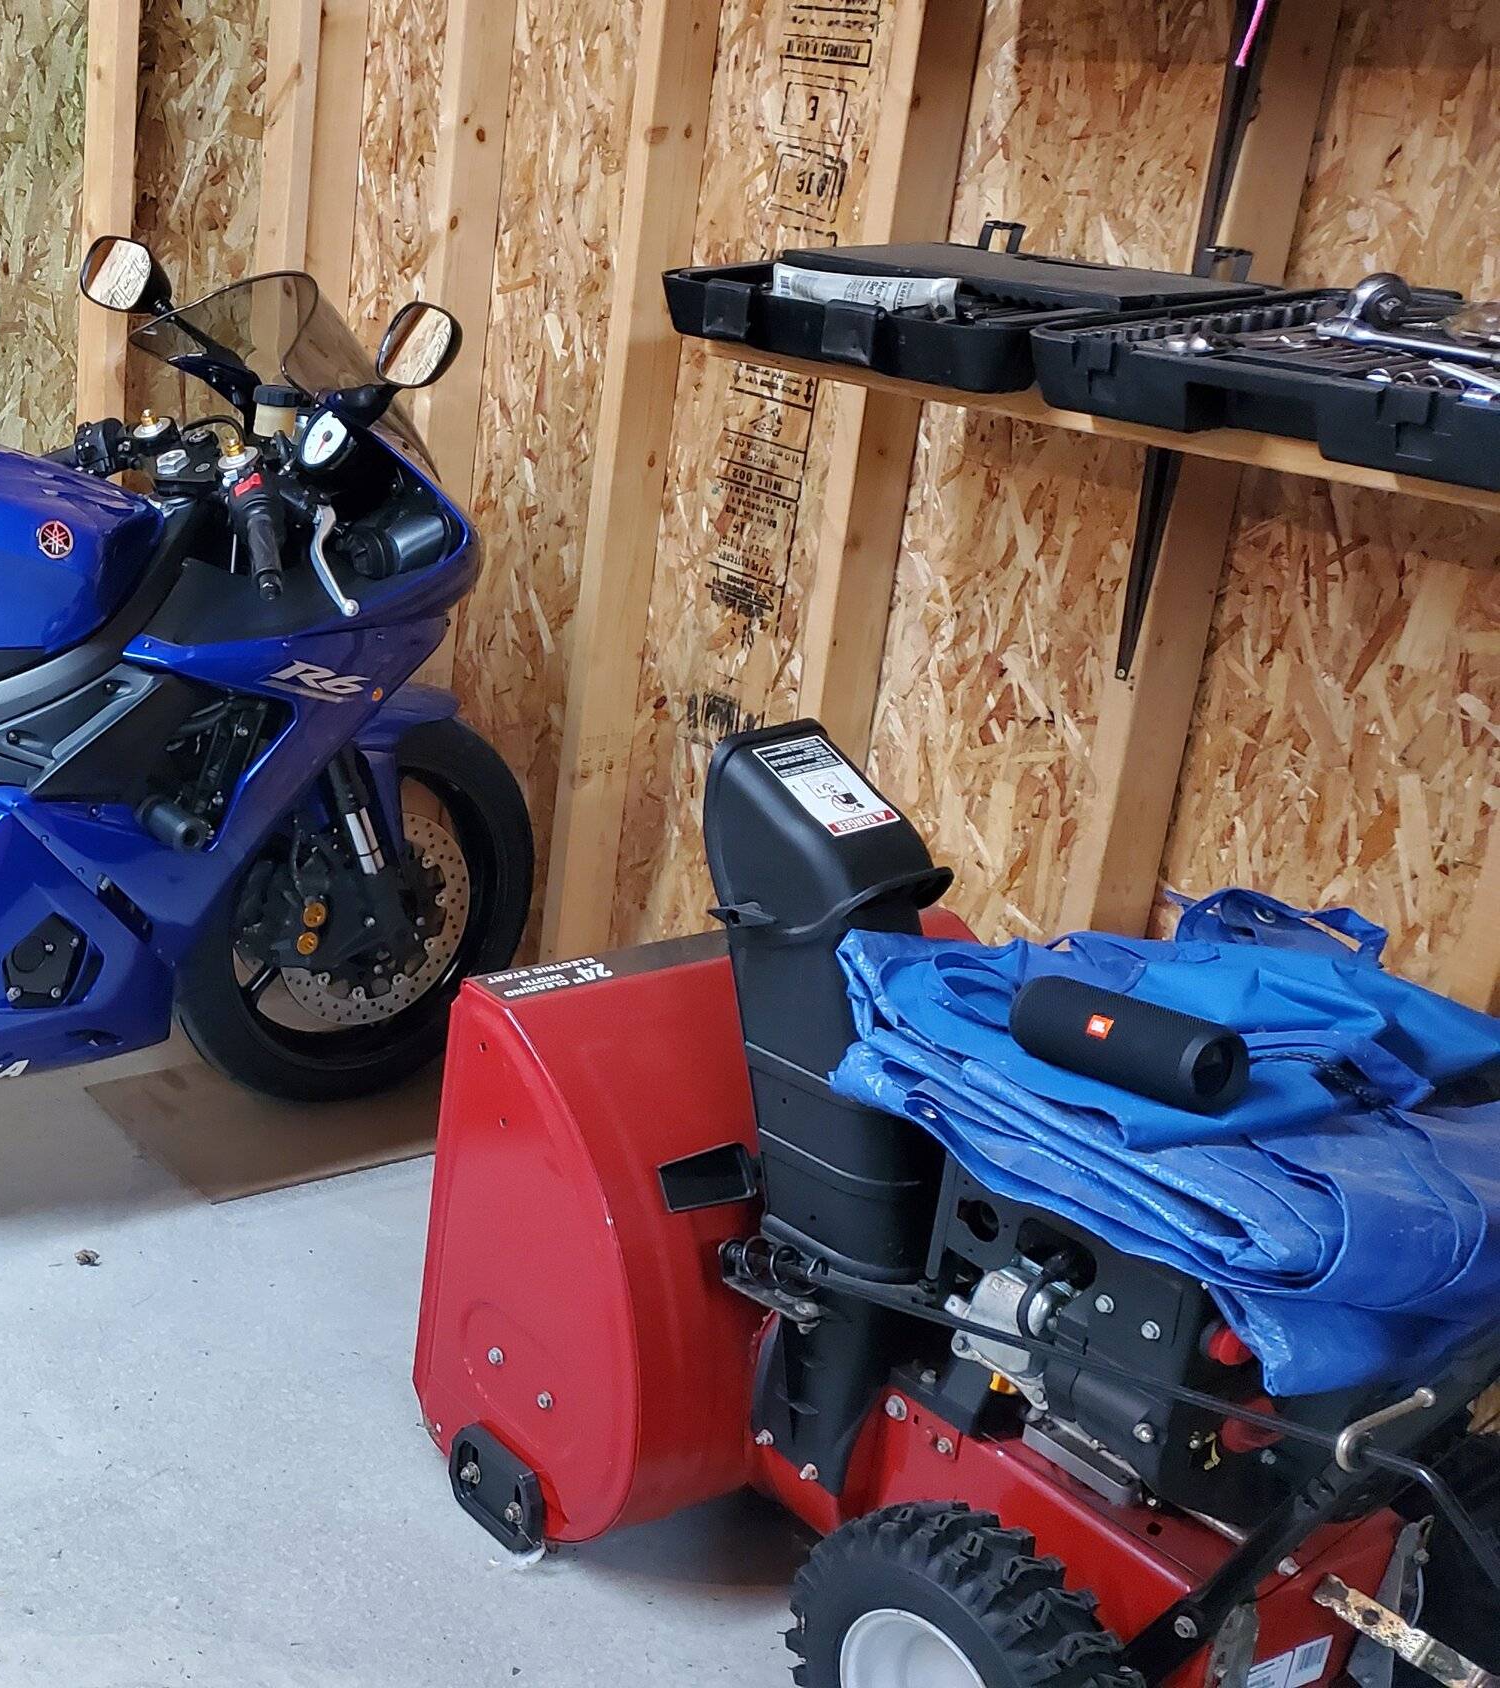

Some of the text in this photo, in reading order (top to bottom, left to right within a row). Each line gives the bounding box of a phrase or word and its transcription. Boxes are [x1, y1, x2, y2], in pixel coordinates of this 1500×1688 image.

[732, 468, 782, 491] MILL 002
[269, 660, 371, 694] R6
[835, 814, 878, 832] DANGER
[487, 957, 596, 985] ELECTRIC START
[520, 973, 566, 987] WIDTH
[503, 979, 570, 997] CLEARING
